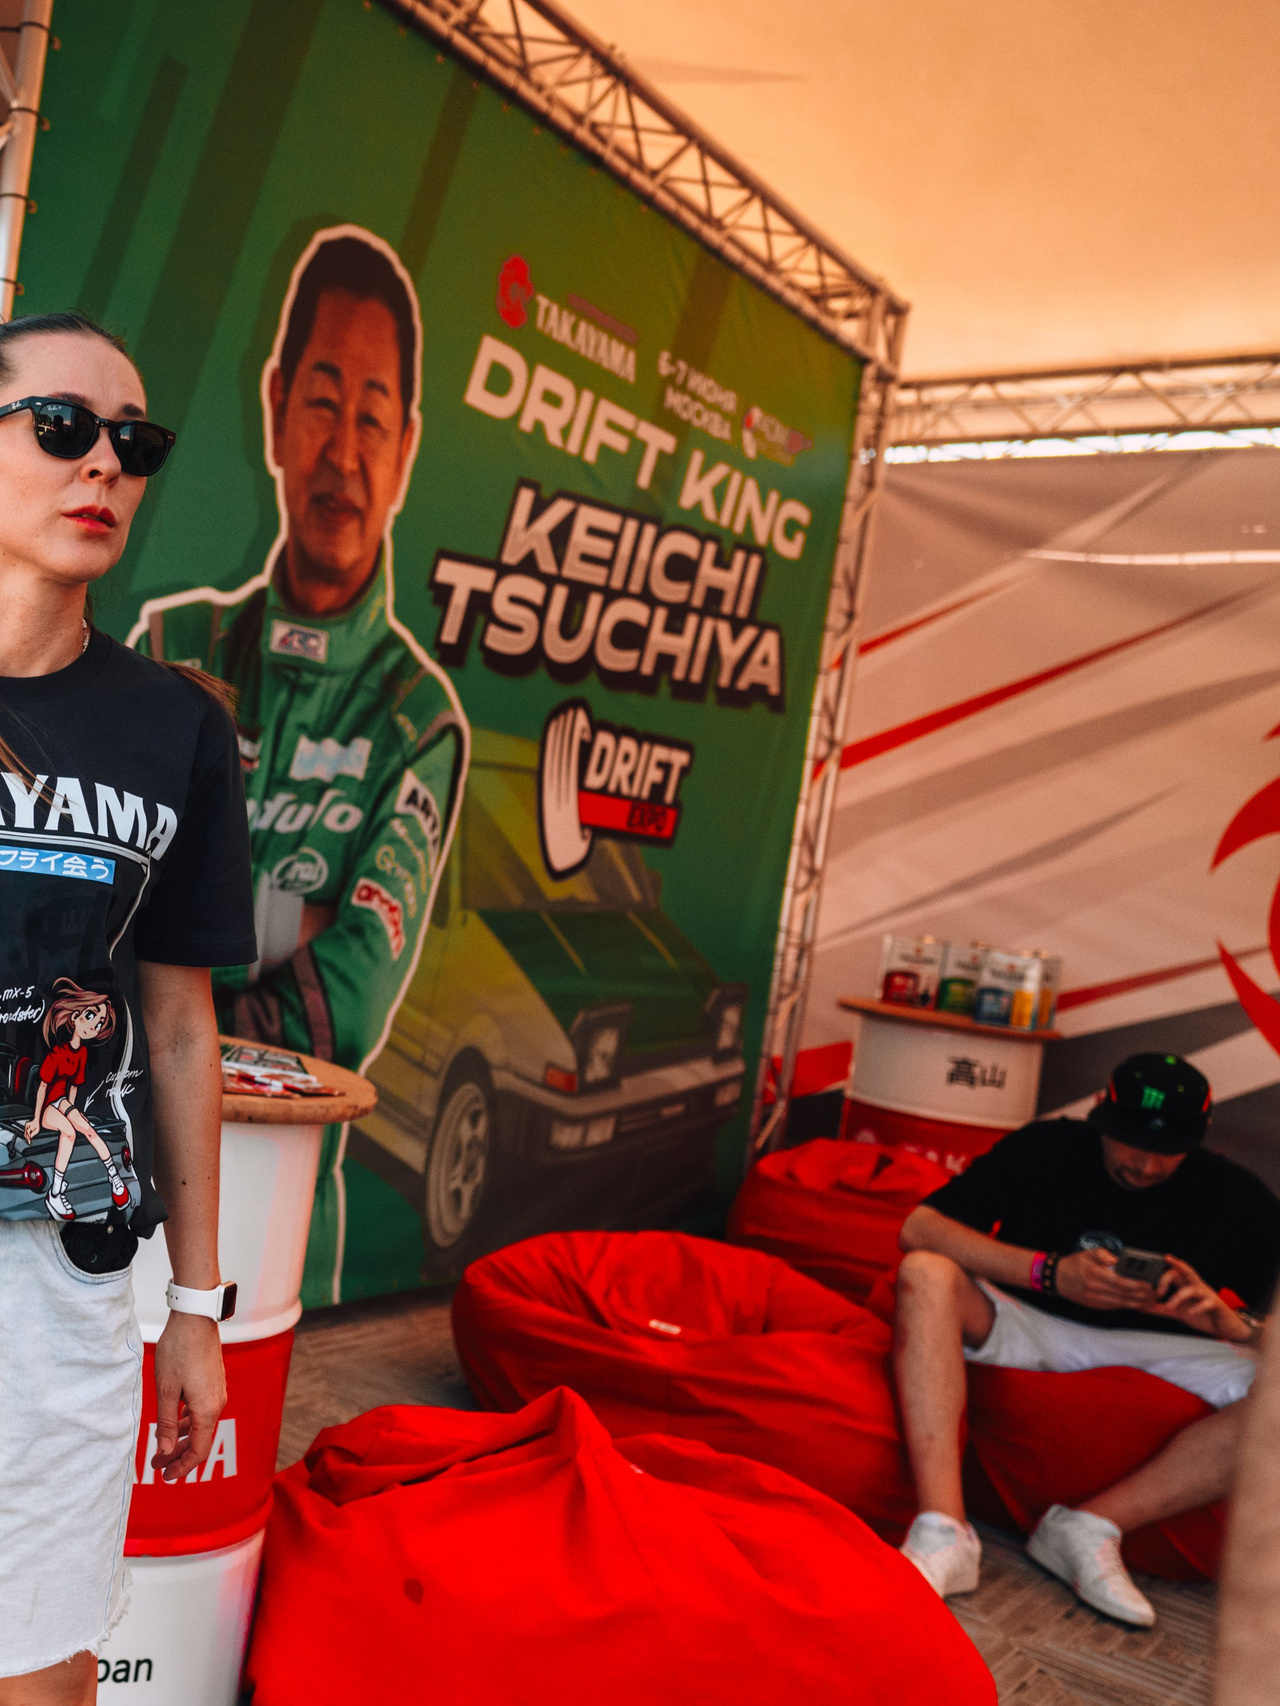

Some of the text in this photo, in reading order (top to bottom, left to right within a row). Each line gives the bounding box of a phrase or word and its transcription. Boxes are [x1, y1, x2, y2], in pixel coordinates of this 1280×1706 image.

[535, 293, 636, 384] TAKAYAMA
[464, 334, 677, 489] DRIFT
[501, 487, 763, 619] KEIICHI
[679, 449, 812, 560] KING
[434, 556, 781, 696] TSUCHIYA
[584, 736, 690, 803] DRIFT
[627, 806, 667, 832] EXPO
[947, 1055, 1007, 1090] 高山
